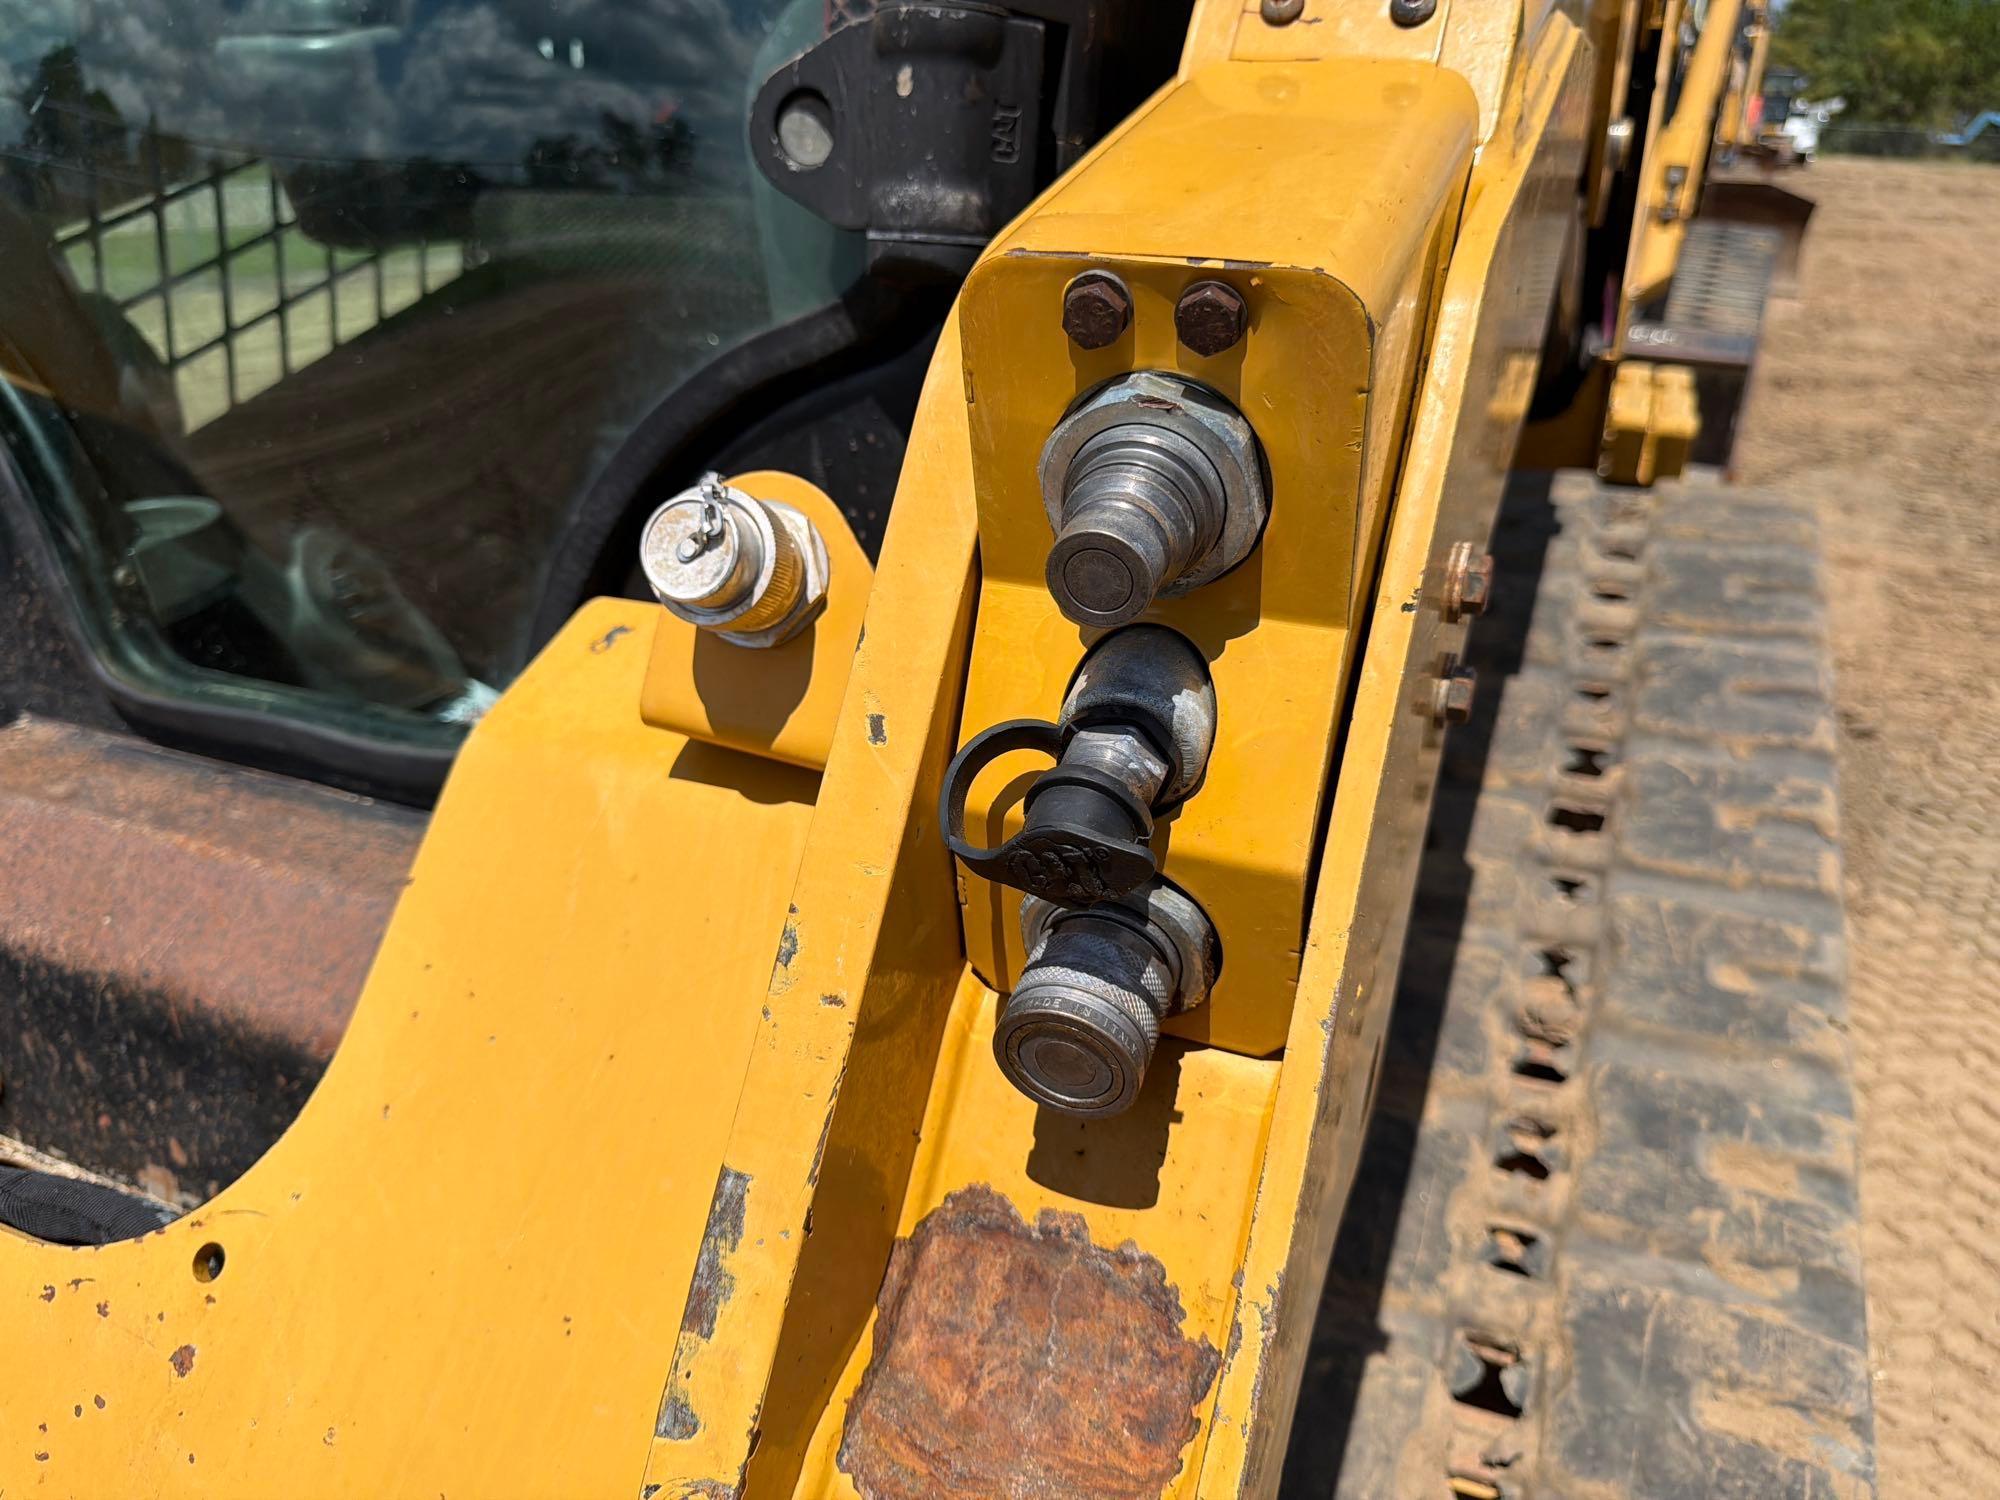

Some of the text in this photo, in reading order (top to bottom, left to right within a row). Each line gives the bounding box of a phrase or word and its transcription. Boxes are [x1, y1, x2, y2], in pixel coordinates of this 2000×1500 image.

[992, 101, 1022, 163] CAT
[1026, 997, 1138, 1055] MADE IN ITALY
